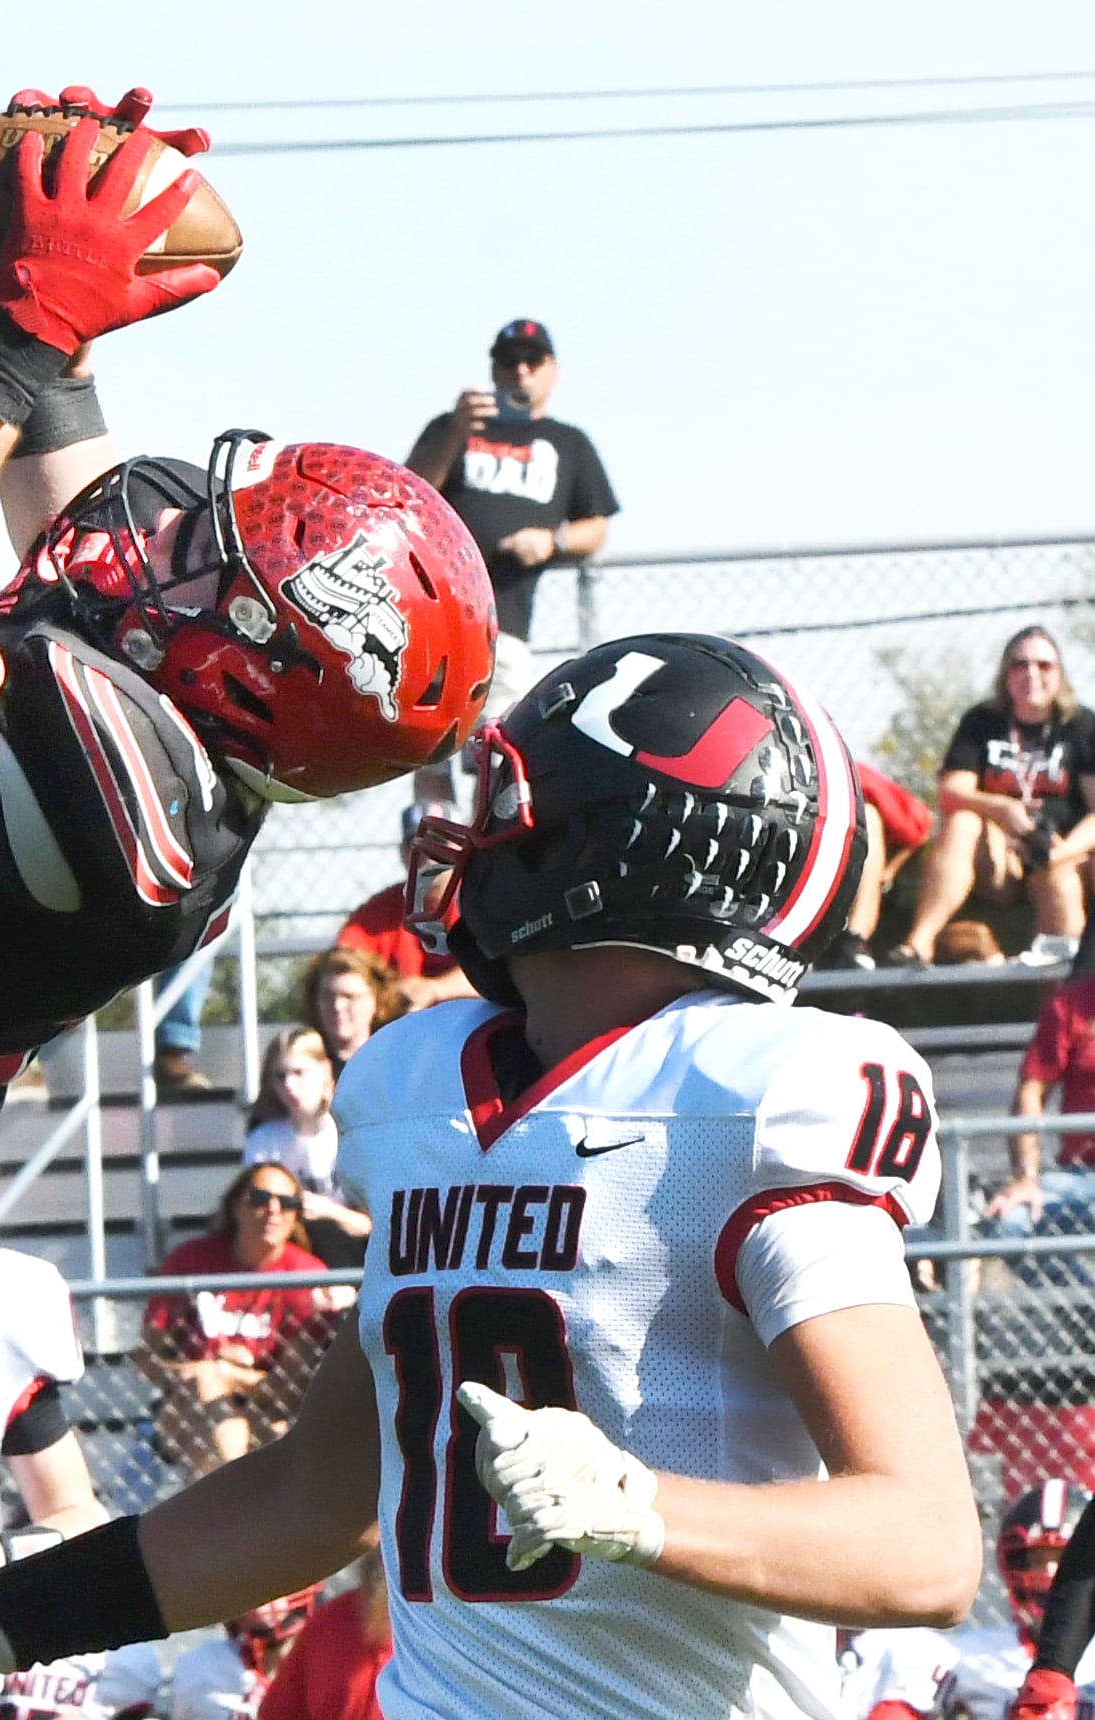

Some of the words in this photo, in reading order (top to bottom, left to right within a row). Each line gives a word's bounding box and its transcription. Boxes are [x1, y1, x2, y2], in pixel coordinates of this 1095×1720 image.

[510, 912, 554, 944] schutt
[724, 937, 806, 988] schutt
[844, 1061, 932, 1183] 18
[388, 1184, 587, 1276] UNITED
[7, 1671, 89, 1707] NITED
